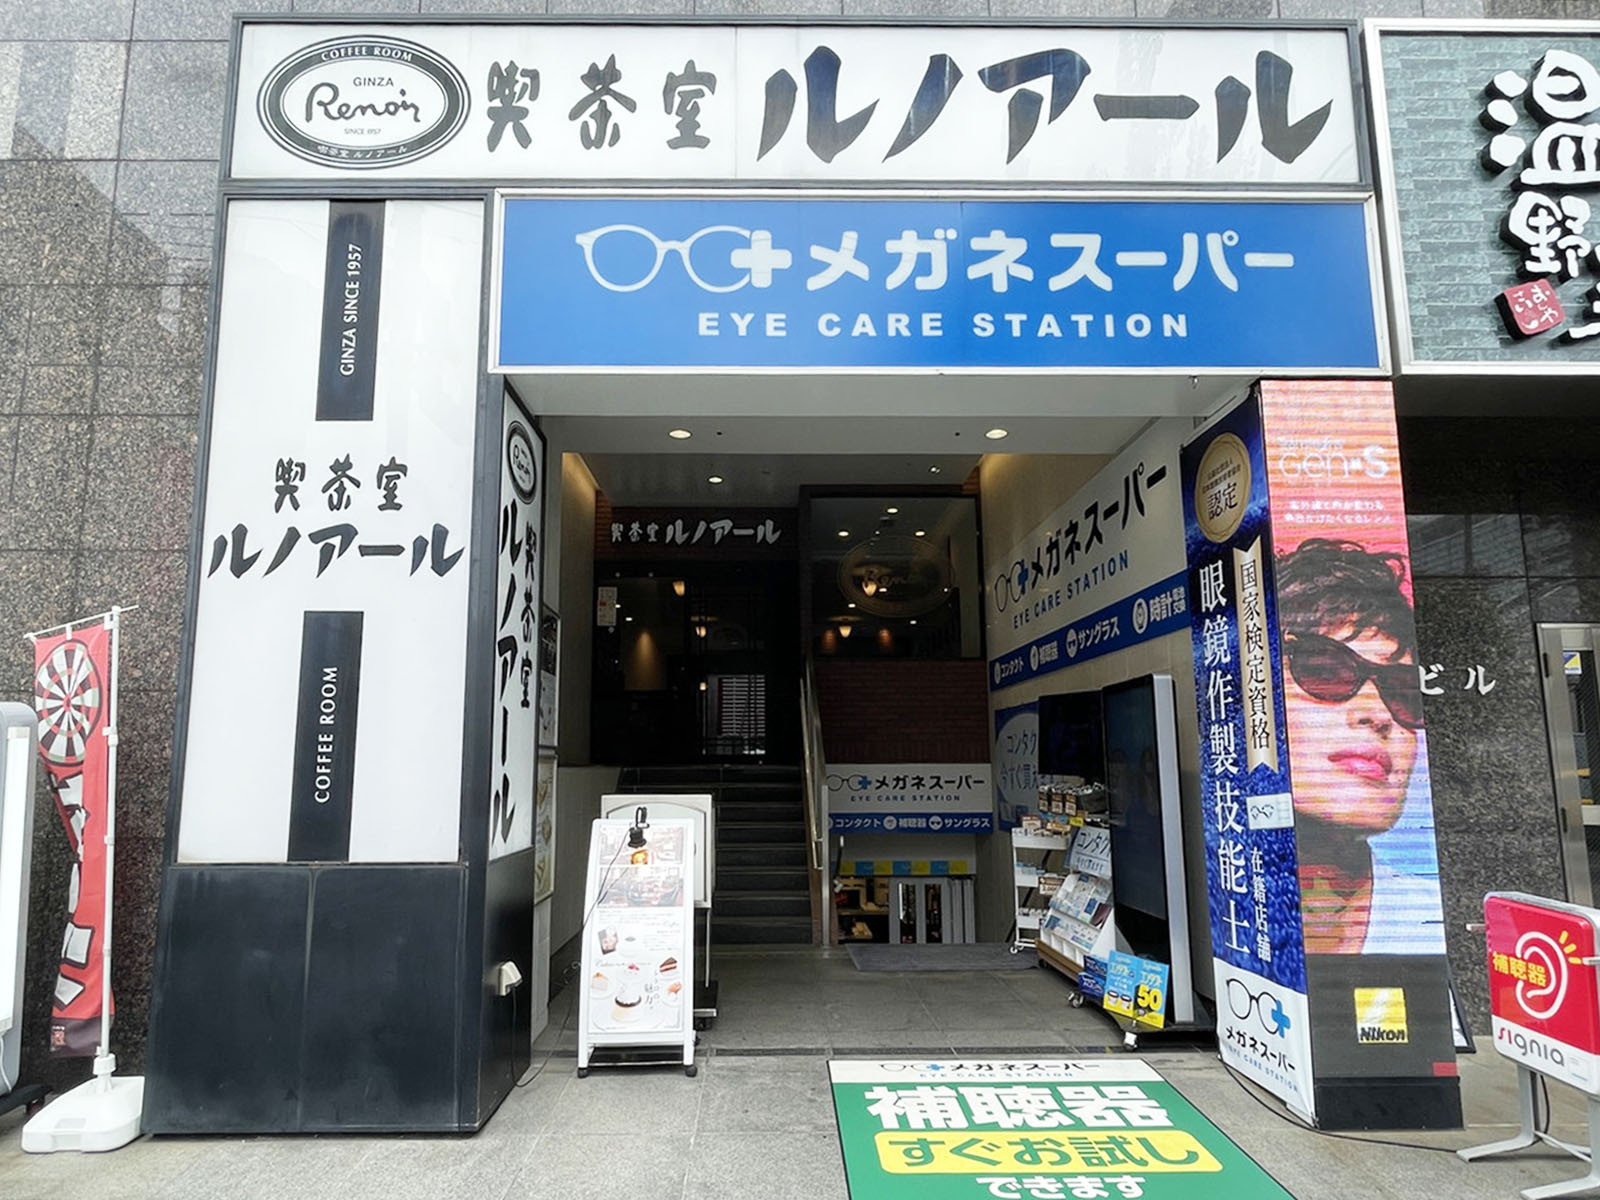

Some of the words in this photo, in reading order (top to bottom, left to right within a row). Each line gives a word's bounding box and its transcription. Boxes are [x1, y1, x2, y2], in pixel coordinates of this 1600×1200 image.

[321, 46, 367, 61] COFFEE
[374, 46, 413, 62] ROOM
[353, 77, 394, 87] GINZA
[305, 82, 421, 123] Renoir
[486, 54, 718, 153] 喫茶室
[757, 46, 1334, 165] ルノアール
[346, 243, 362, 274] 1957
[807, 228, 1294, 293] メガネスーパー
[343, 277, 359, 325] SINCE
[698, 312, 788, 337] EYE
[817, 312, 944, 337] CARE
[973, 312, 1188, 337] STATION
[339, 328, 356, 376] GINZA
[274, 453, 408, 514] 喫茶室
[1207, 482, 1238, 520] 認定
[665, 519, 782, 545] ルノアール
[1031, 462, 1167, 590] メガネスーパー
[207, 523, 466, 578] ルノアール
[1013, 610, 1031, 630] EYE
[1034, 590, 1062, 618] CARE
[1067, 549, 1129, 600] STATION
[1078, 616, 1120, 649] サングラス
[491, 499, 523, 844] ルノアール
[1240, 559, 1270, 750] 国家検定資格
[319, 666, 338, 726] ROOM
[1418, 663, 1496, 696] ビル
[314, 732, 334, 804] COFFEE
[1200, 559, 1251, 955] 眼鏡作製技能士
[875, 775, 985, 791] メガネスーパー
[835, 818, 881, 828] コンタクト
[944, 818, 990, 829] サングラス
[1077, 831, 1110, 858] コンタク
[1250, 846, 1272, 963] 在籍店舗
[1492, 951, 1546, 988] 補聴器
[1136, 983, 1163, 1012] 50
[1226, 1026, 1296, 1073] メガネスーパー
[1360, 1027, 1406, 1042] Nikon
[1498, 1027, 1565, 1067] signia
[950, 1062, 1100, 1073] メガネスーパー
[863, 1085, 1174, 1130] 補聴器
[888, 1137, 1199, 1168] すぐお試し
[975, 1174, 1146, 1200] できます
